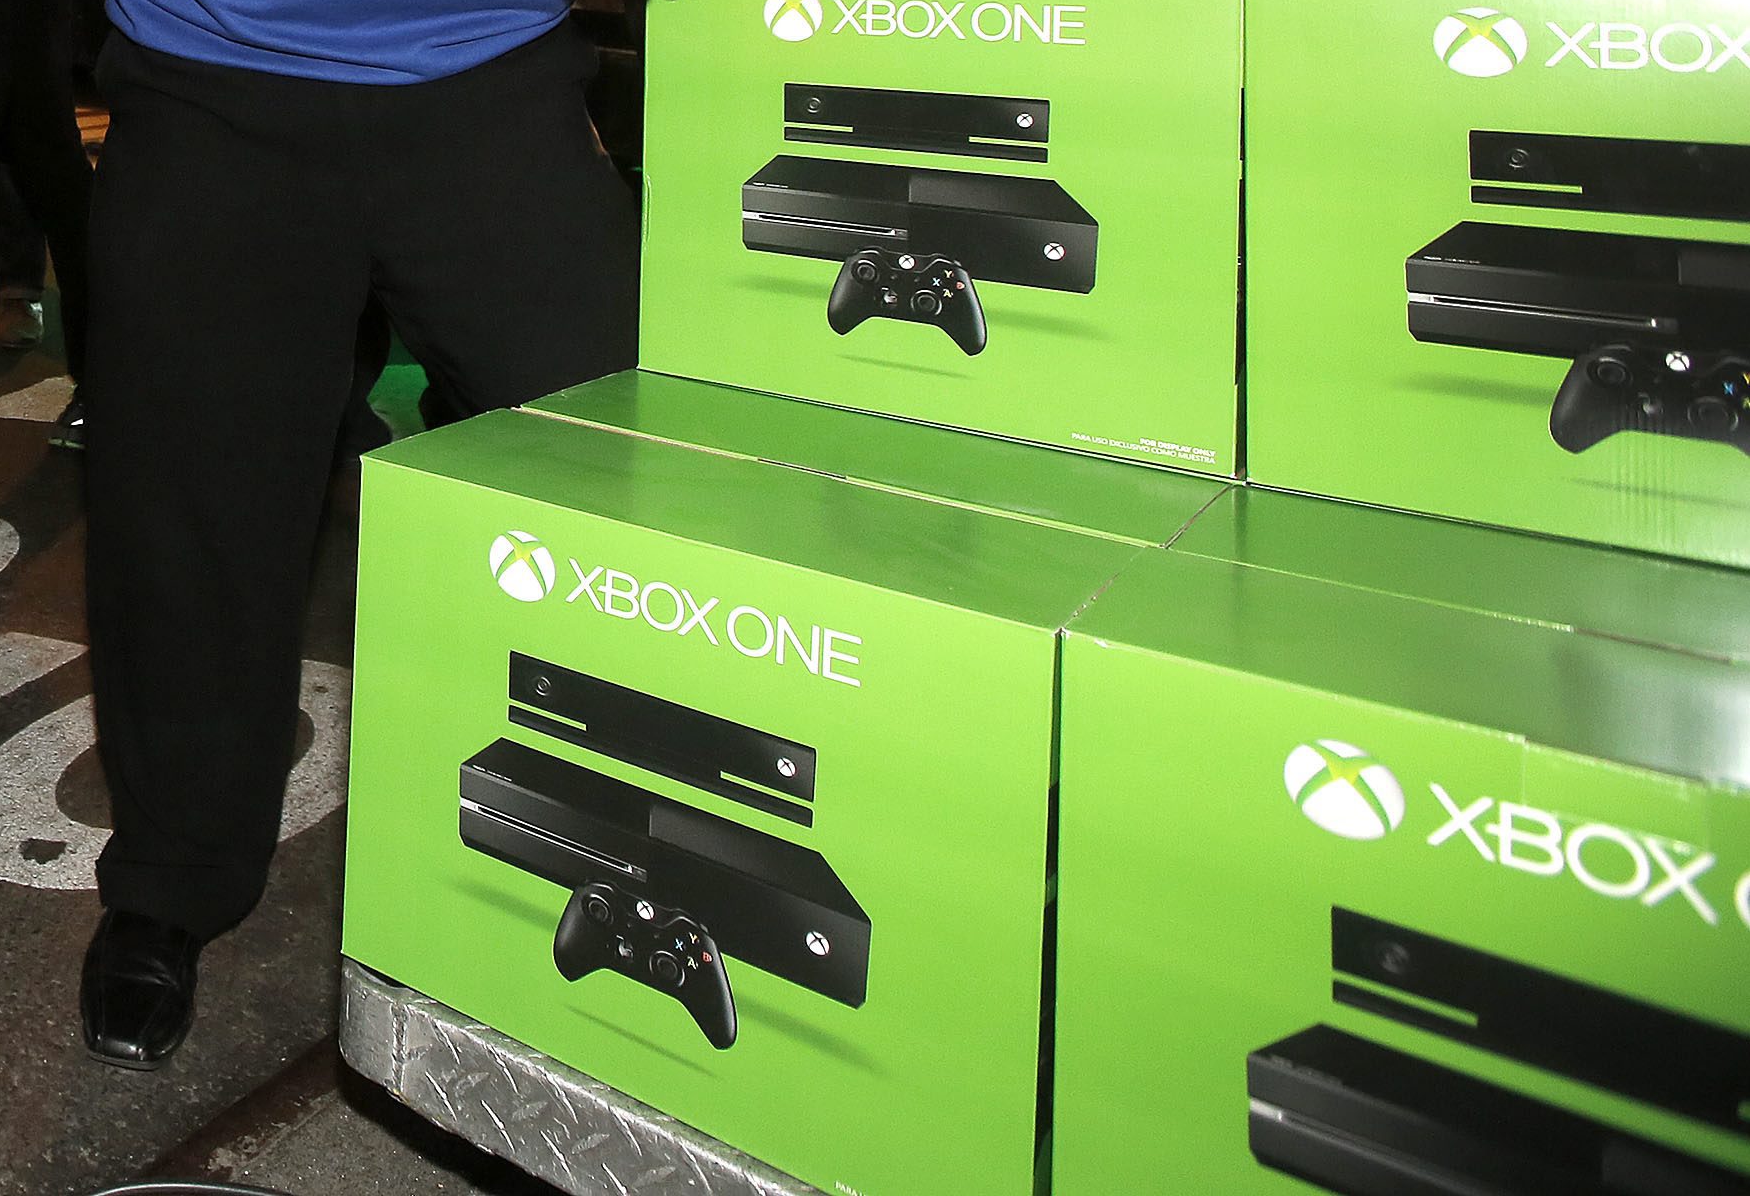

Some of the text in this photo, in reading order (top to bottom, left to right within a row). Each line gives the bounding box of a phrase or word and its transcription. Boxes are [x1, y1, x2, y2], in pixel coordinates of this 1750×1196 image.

[970, 1, 1087, 45] ONE
[1544, 20, 1750, 73] XBOX
[565, 556, 863, 688] XBOX ONE
[1426, 781, 1718, 926] XBOX
